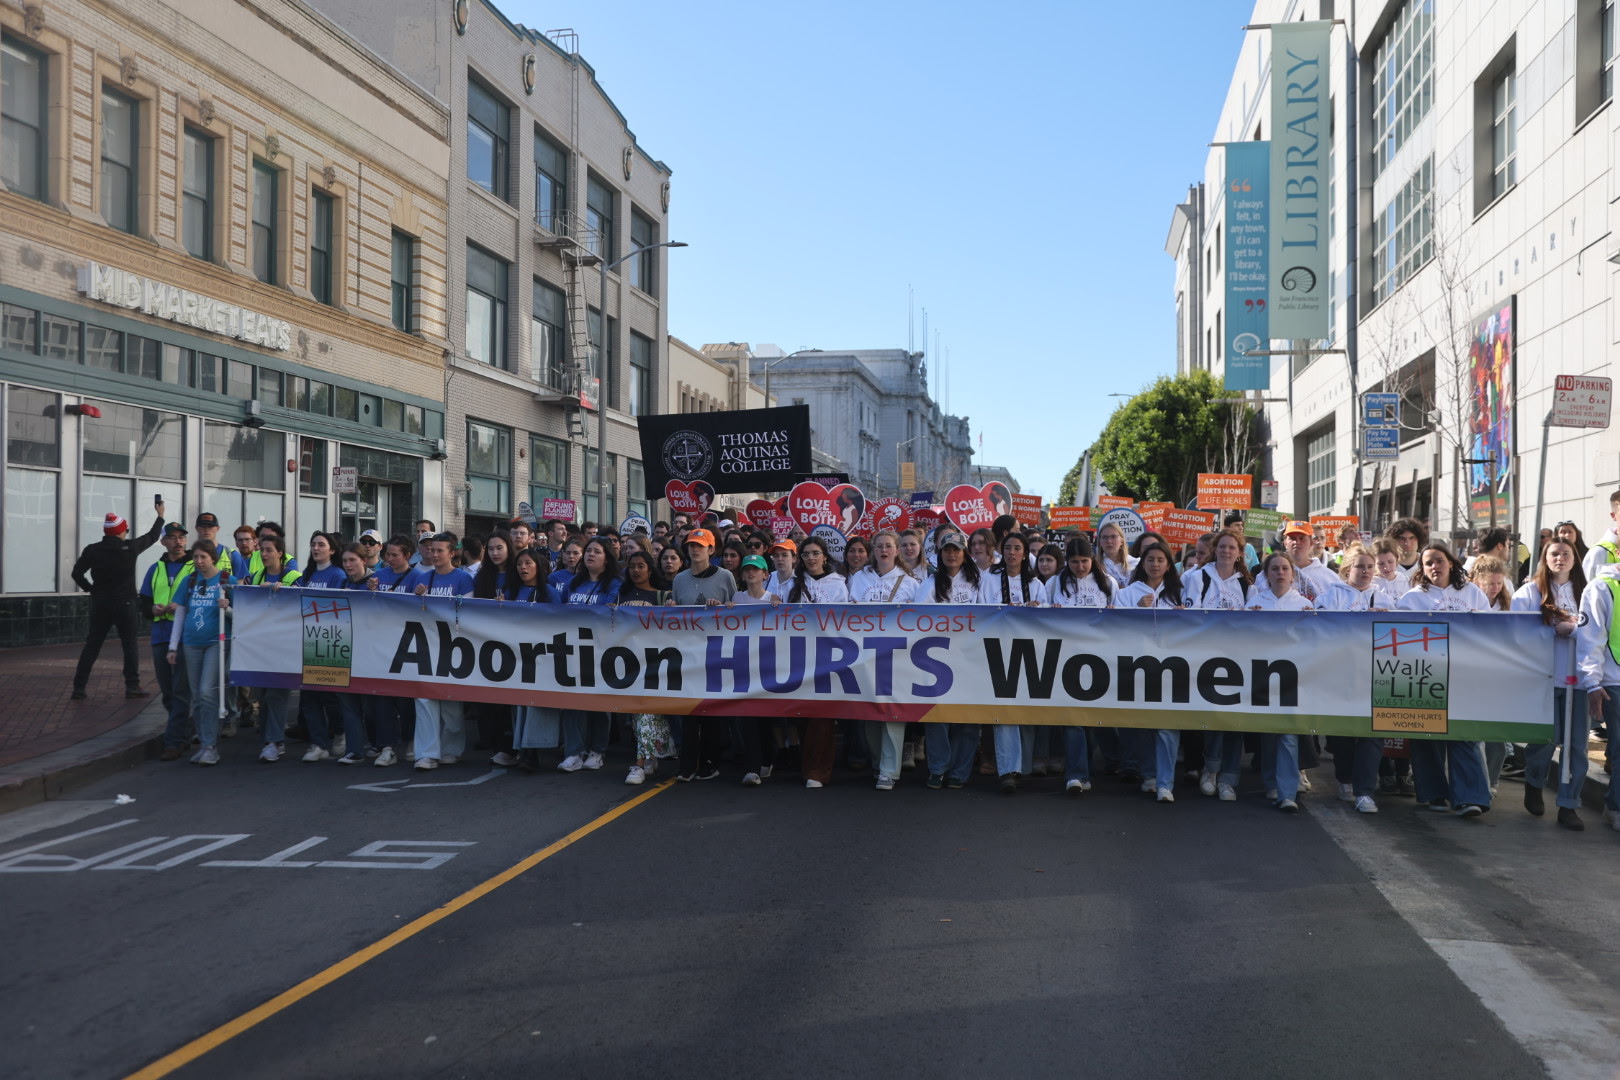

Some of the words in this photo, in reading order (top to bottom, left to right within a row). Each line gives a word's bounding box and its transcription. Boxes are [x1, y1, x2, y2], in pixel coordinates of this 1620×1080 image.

[1282, 48, 1319, 252] LIBRARY
[1238, 200, 1264, 210] always
[1231, 226, 1244, 234] any
[1234, 249, 1246, 259] get
[1470, 216, 1577, 305] LIBRARY
[90, 262, 142, 309] MID
[144, 279, 238, 338] MARKET
[239, 308, 291, 349] EATS
[1558, 376, 1574, 390] NO
[1576, 380, 1610, 392] PARKING
[1560, 392, 1566, 402] 2
[1589, 395, 1596, 404] 6
[718, 430, 788, 446] THOMAS
[720, 444, 790, 463] AQUINAS
[720, 458, 791, 474] COLLEGE
[670, 490, 690, 498] LOVE
[545, 502, 573, 510] DEFUND
[796, 498, 830, 510] LOVE
[952, 499, 984, 512] LOVE
[800, 512, 836, 526] BOTH
[960, 512, 993, 525] BOTH
[1140, 508, 1164, 517] BORTIO
[1168, 513, 1206, 522] ABORTION
[1248, 512, 1279, 520] ABORTION
[1163, 521, 1184, 529] HURTS
[1185, 524, 1212, 532] WOMEN
[638, 611, 704, 632] Walk
[712, 608, 751, 631] for
[761, 607, 806, 631] Life
[816, 609, 886, 632] West
[896, 609, 976, 632] Coast
[306, 625, 342, 640] Walk
[315, 640, 350, 659] Life
[388, 620, 682, 691] Abortion
[705, 636, 955, 698] HURTS
[983, 637, 1299, 706] Women
[1376, 659, 1432, 676] Walk
[1391, 676, 1445, 699] Life
[0, 834, 479, 871] STOP
